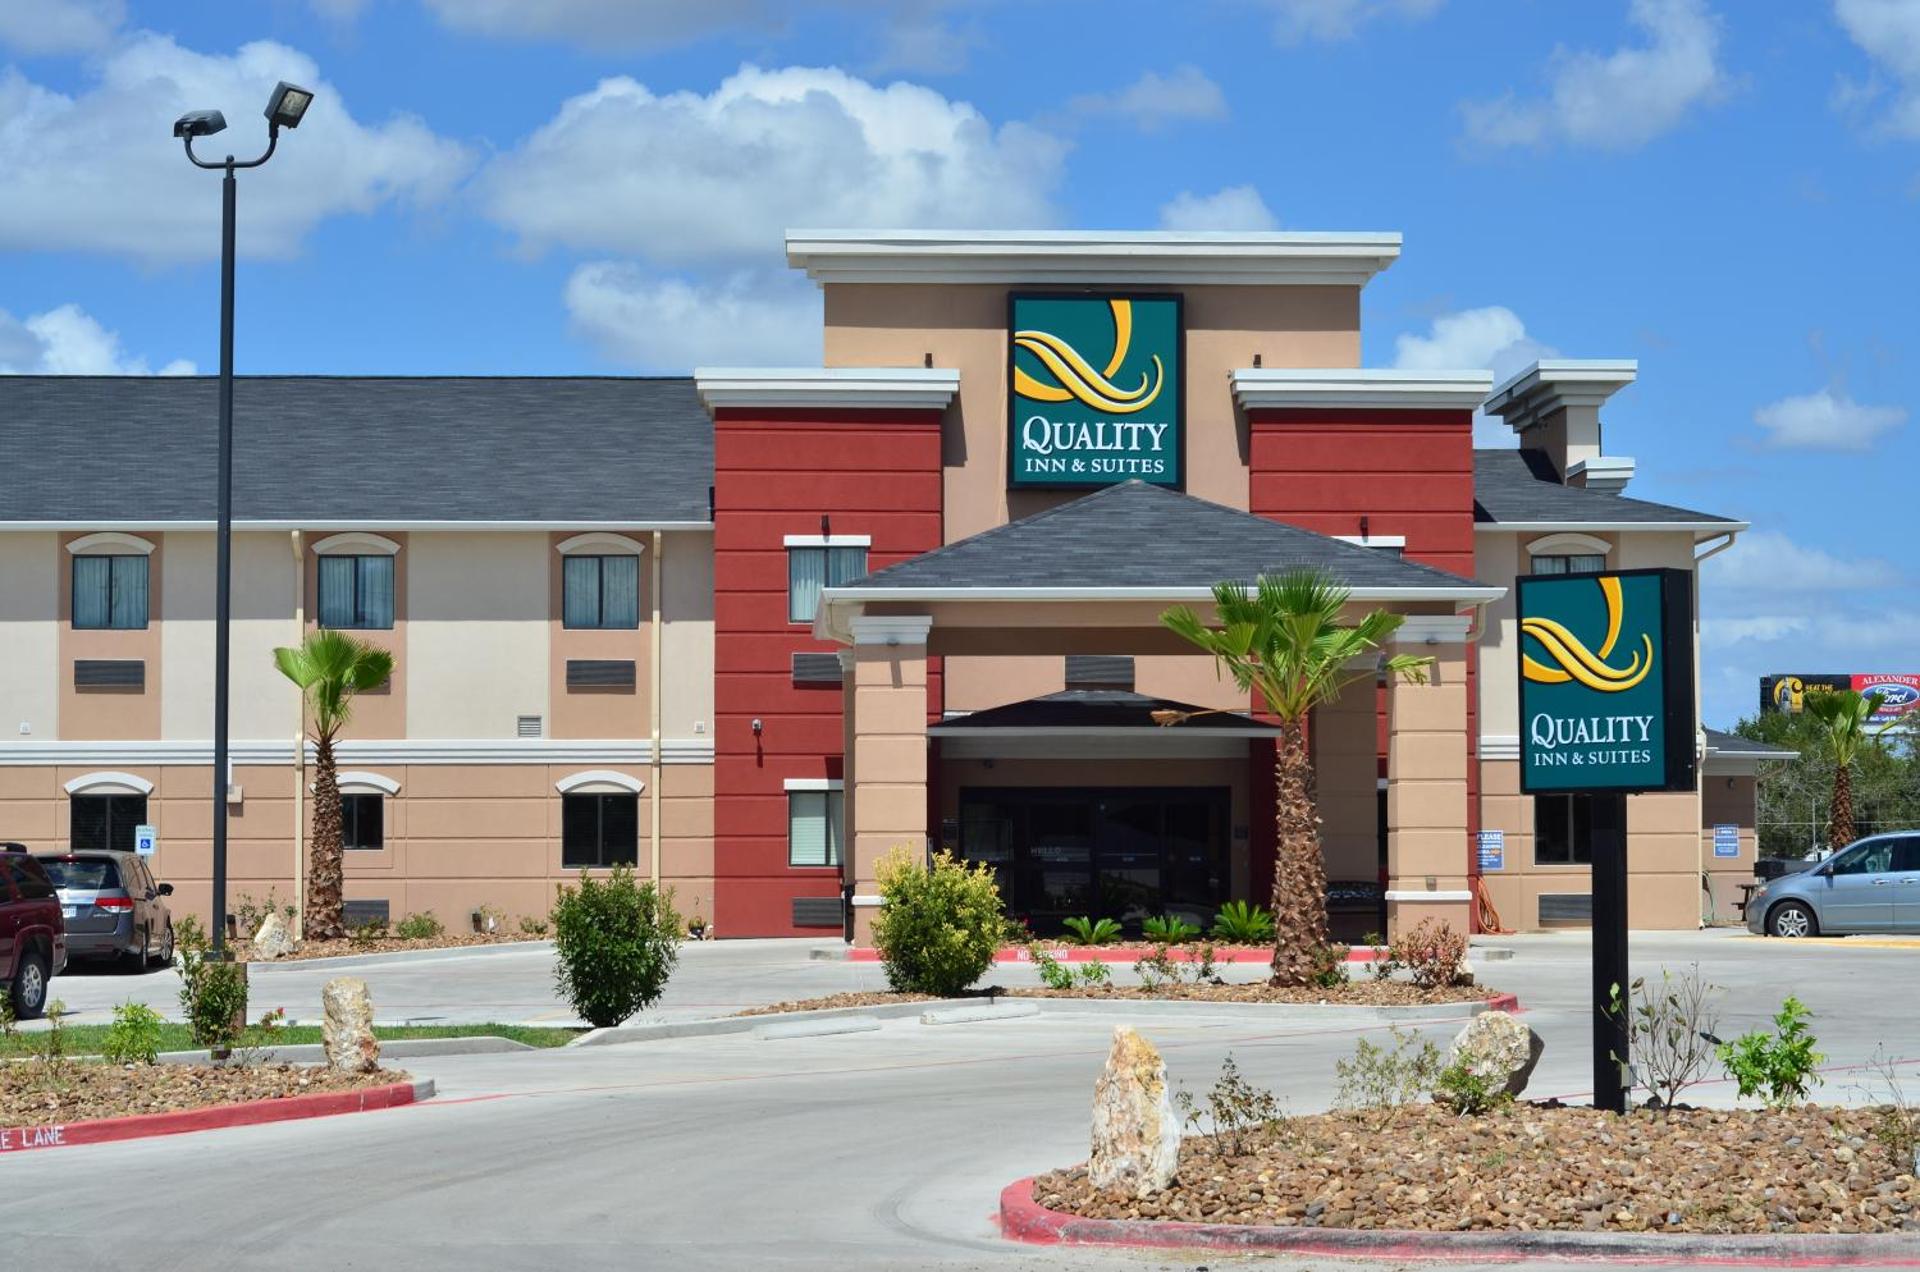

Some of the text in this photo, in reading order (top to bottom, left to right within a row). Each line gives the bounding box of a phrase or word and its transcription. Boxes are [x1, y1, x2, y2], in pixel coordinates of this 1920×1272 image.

[1023, 416, 1168, 455] QUALITY
[1025, 458, 1164, 474] INN & SUITES
[1863, 675, 1918, 685] ALEXANDER
[1531, 713, 1654, 749] QUALITY
[1535, 749, 1651, 766] INN & SUITES
[1017, 949, 1029, 960] NO
[0, 1126, 65, 1149] E LANE
